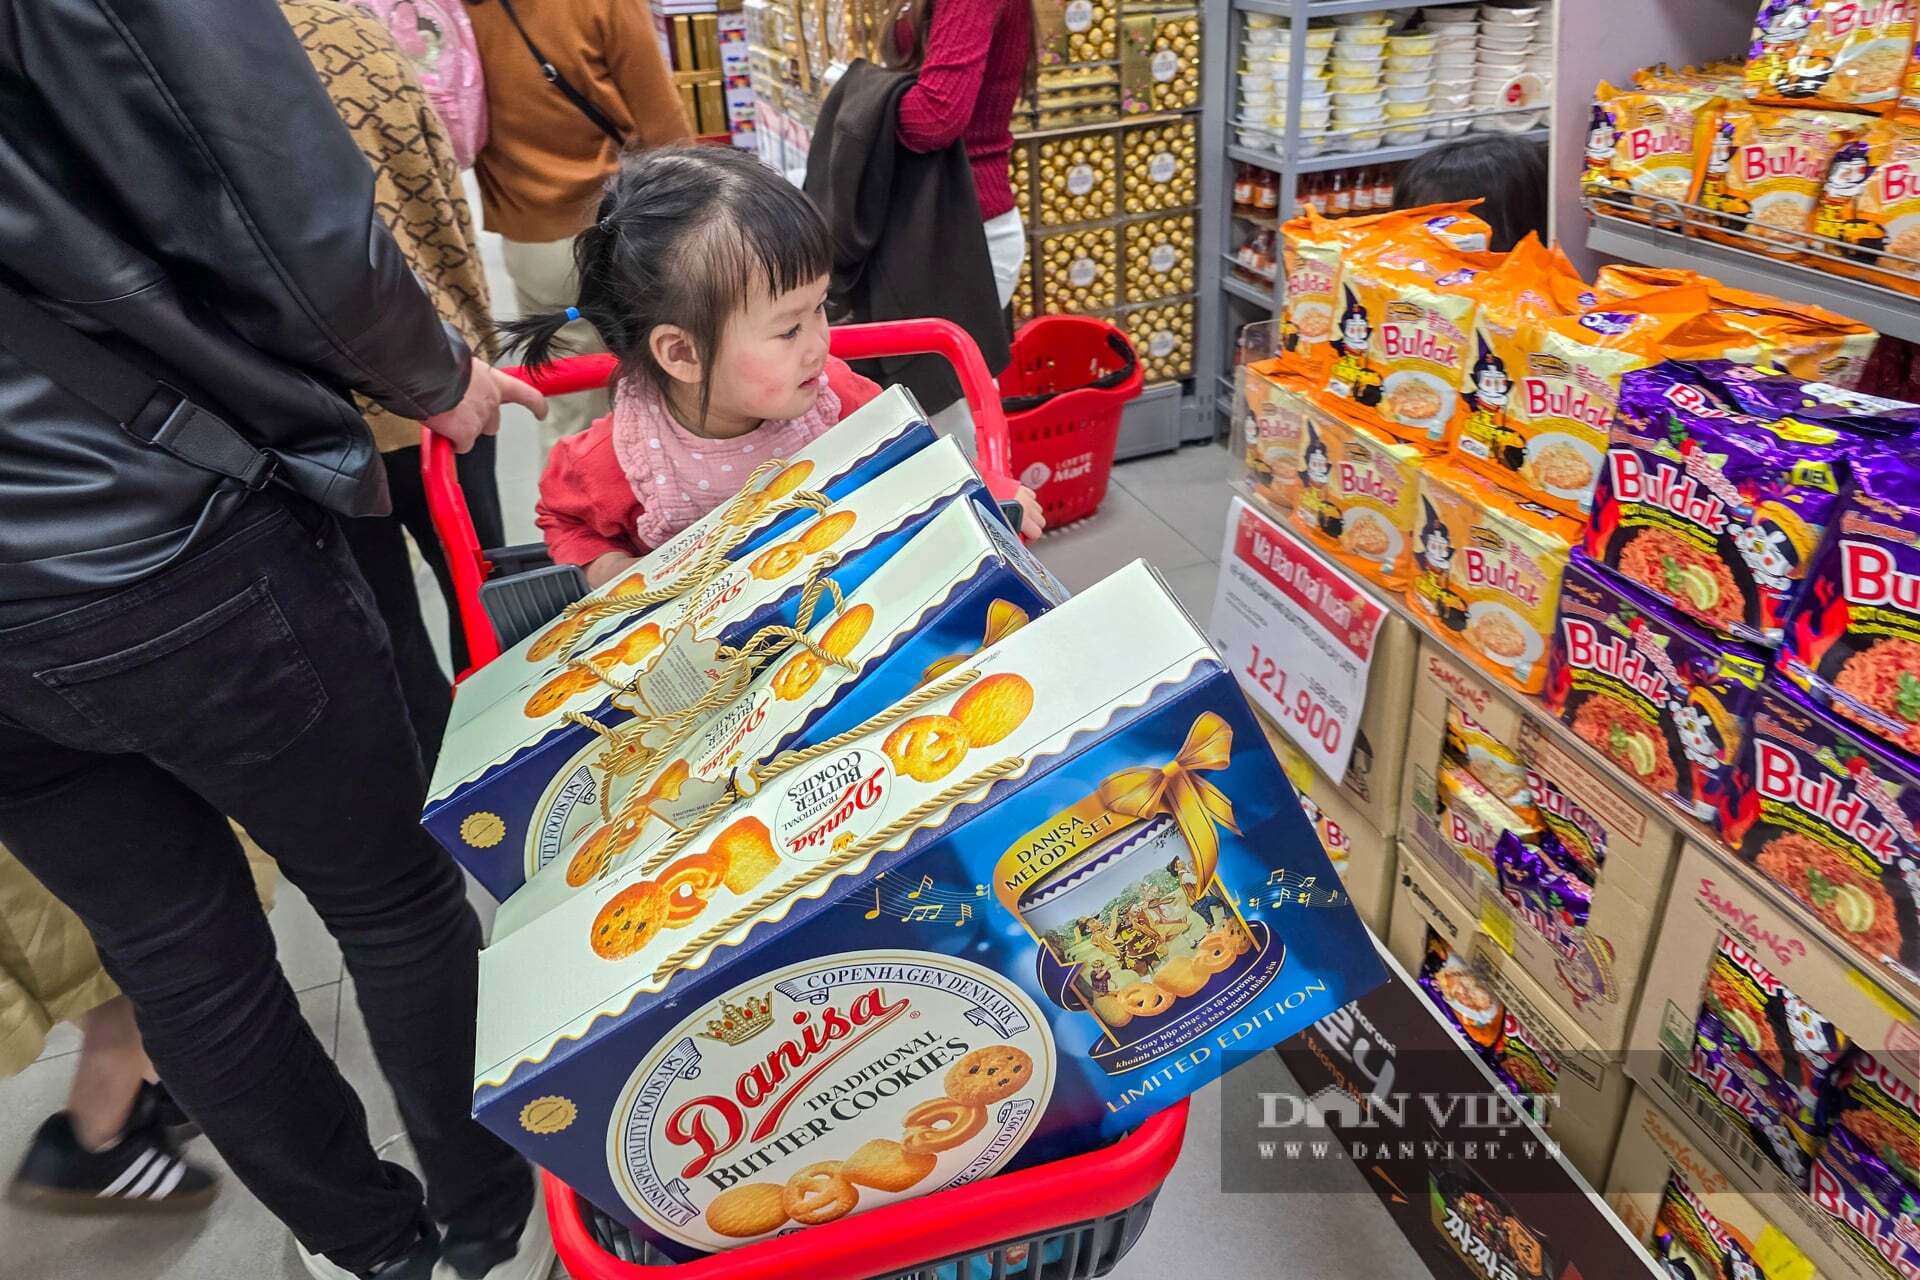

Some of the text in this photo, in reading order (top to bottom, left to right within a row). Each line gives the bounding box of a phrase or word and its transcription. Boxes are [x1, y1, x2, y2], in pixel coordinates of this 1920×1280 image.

[1382, 323, 1458, 368] Buldak
[1525, 377, 1611, 432] Buldak
[1339, 462, 1399, 508] Buldak
[1607, 448, 1730, 535] Buldak
[1465, 547, 1540, 608] Buldak
[1561, 617, 1671, 709] Buldak
[704, 692, 756, 739] COOKIES
[707, 702, 754, 746] BUTTER
[1245, 644, 1343, 755] 121,900
[697, 697, 769, 777] Danisa
[787, 750, 863, 803] COOKIES
[795, 765, 862, 813] BUTTER
[1753, 738, 1903, 865] Buldak
[547, 801, 570, 840] FOODS
[781, 793, 839, 831] TRADITIONAL
[785, 767, 886, 856] Danisa
[1015, 815, 1085, 865] DANISA
[1005, 813, 1114, 892] MELODY SET
[806, 965, 1020, 1027] COPENHAGEN DENMARK
[659, 1055, 684, 1082] APS
[802, 1029, 943, 1113] TRADITIONAL
[1105, 978, 1328, 1114] LIMITED EDITION
[1133, 1036, 1160, 1056] Xoay
[633, 1077, 666, 1120] FOODS
[664, 986, 910, 1180] Danisa
[705, 1036, 971, 1193] BUTTER COOKIES
[631, 1121, 655, 1181] SPECIALITY
[975, 1131, 1013, 1168] NETTO
